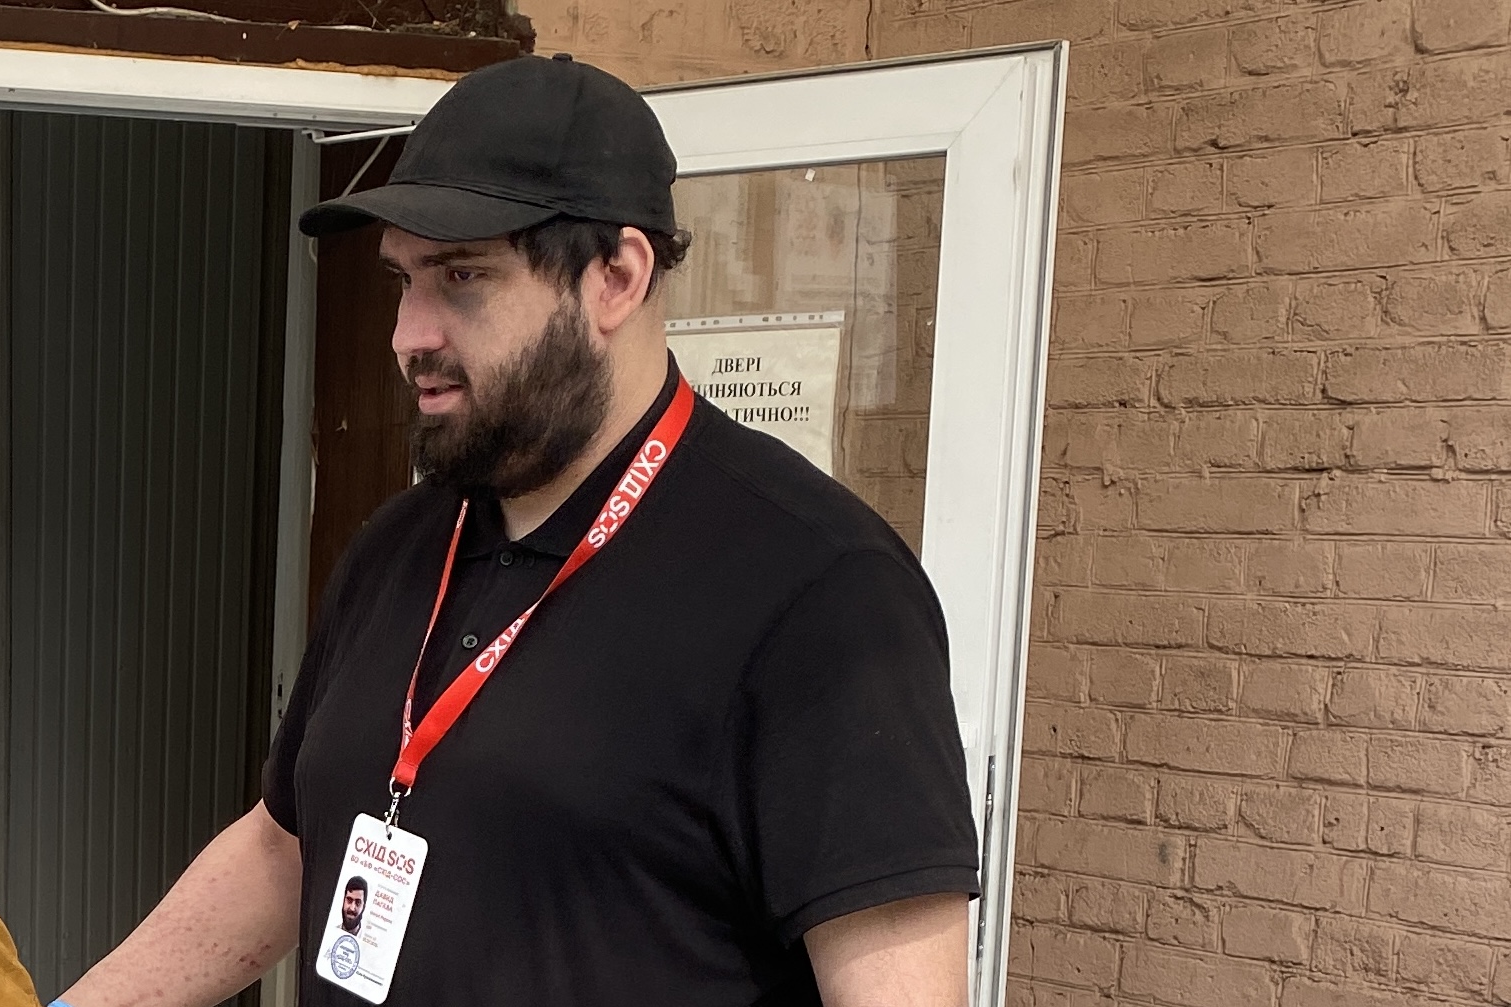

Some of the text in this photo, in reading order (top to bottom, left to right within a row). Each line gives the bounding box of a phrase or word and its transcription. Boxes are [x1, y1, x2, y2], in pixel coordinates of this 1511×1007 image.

[711, 357, 762, 376] ДВЕРІ
[725, 406, 810, 423] ТИЧНО!!!
[588, 439, 666, 549] СХІД SOS
[355, 836, 416, 875] СХІД SOS
